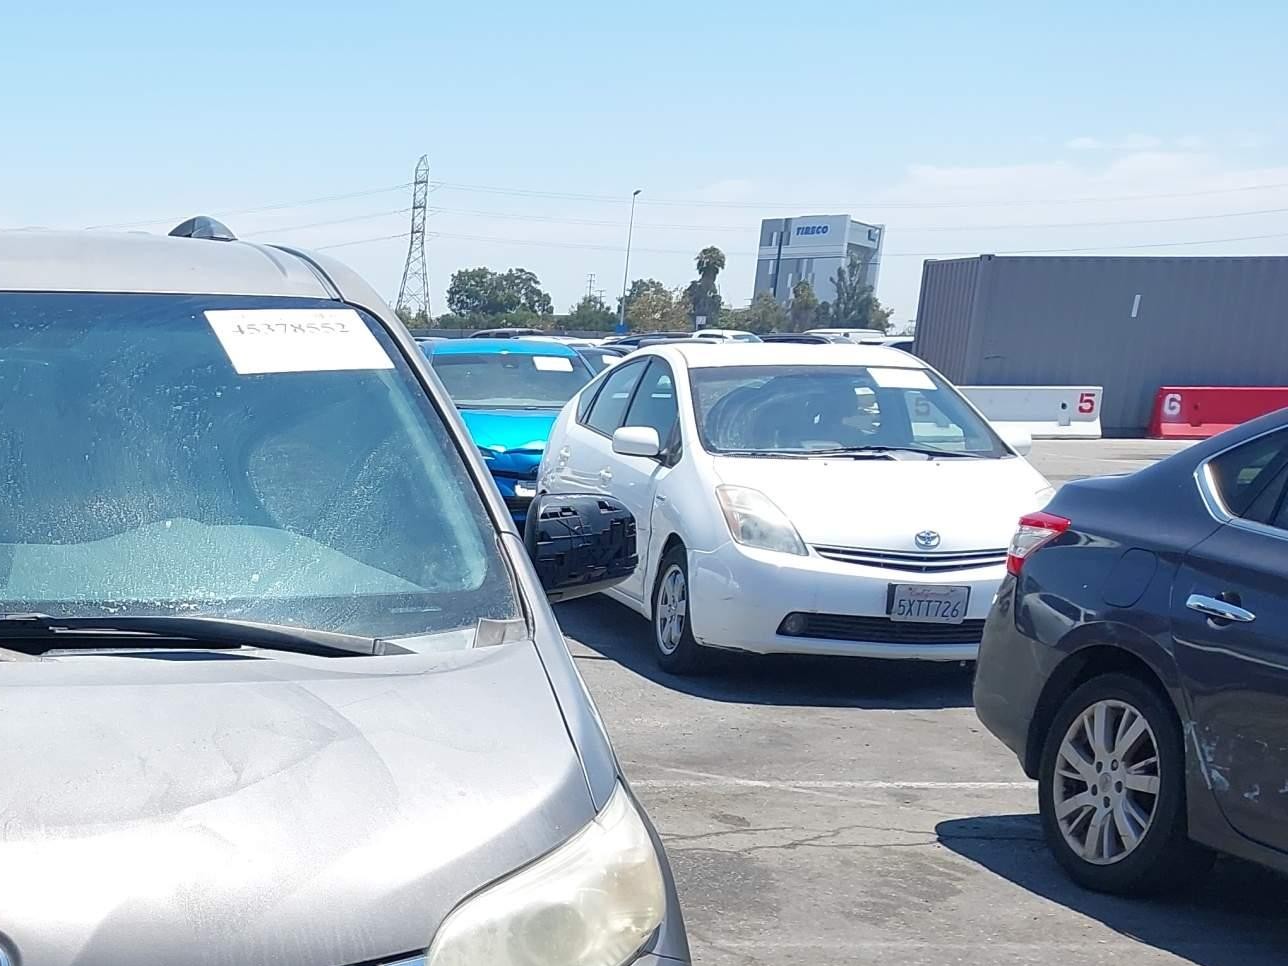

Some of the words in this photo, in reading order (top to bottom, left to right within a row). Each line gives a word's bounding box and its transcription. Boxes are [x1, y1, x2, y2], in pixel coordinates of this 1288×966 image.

[796, 225, 829, 236] TIRECO
[1078, 393, 1096, 414] 5
[1163, 393, 1182, 416] 6
[897, 599, 961, 618] 5XTT726
